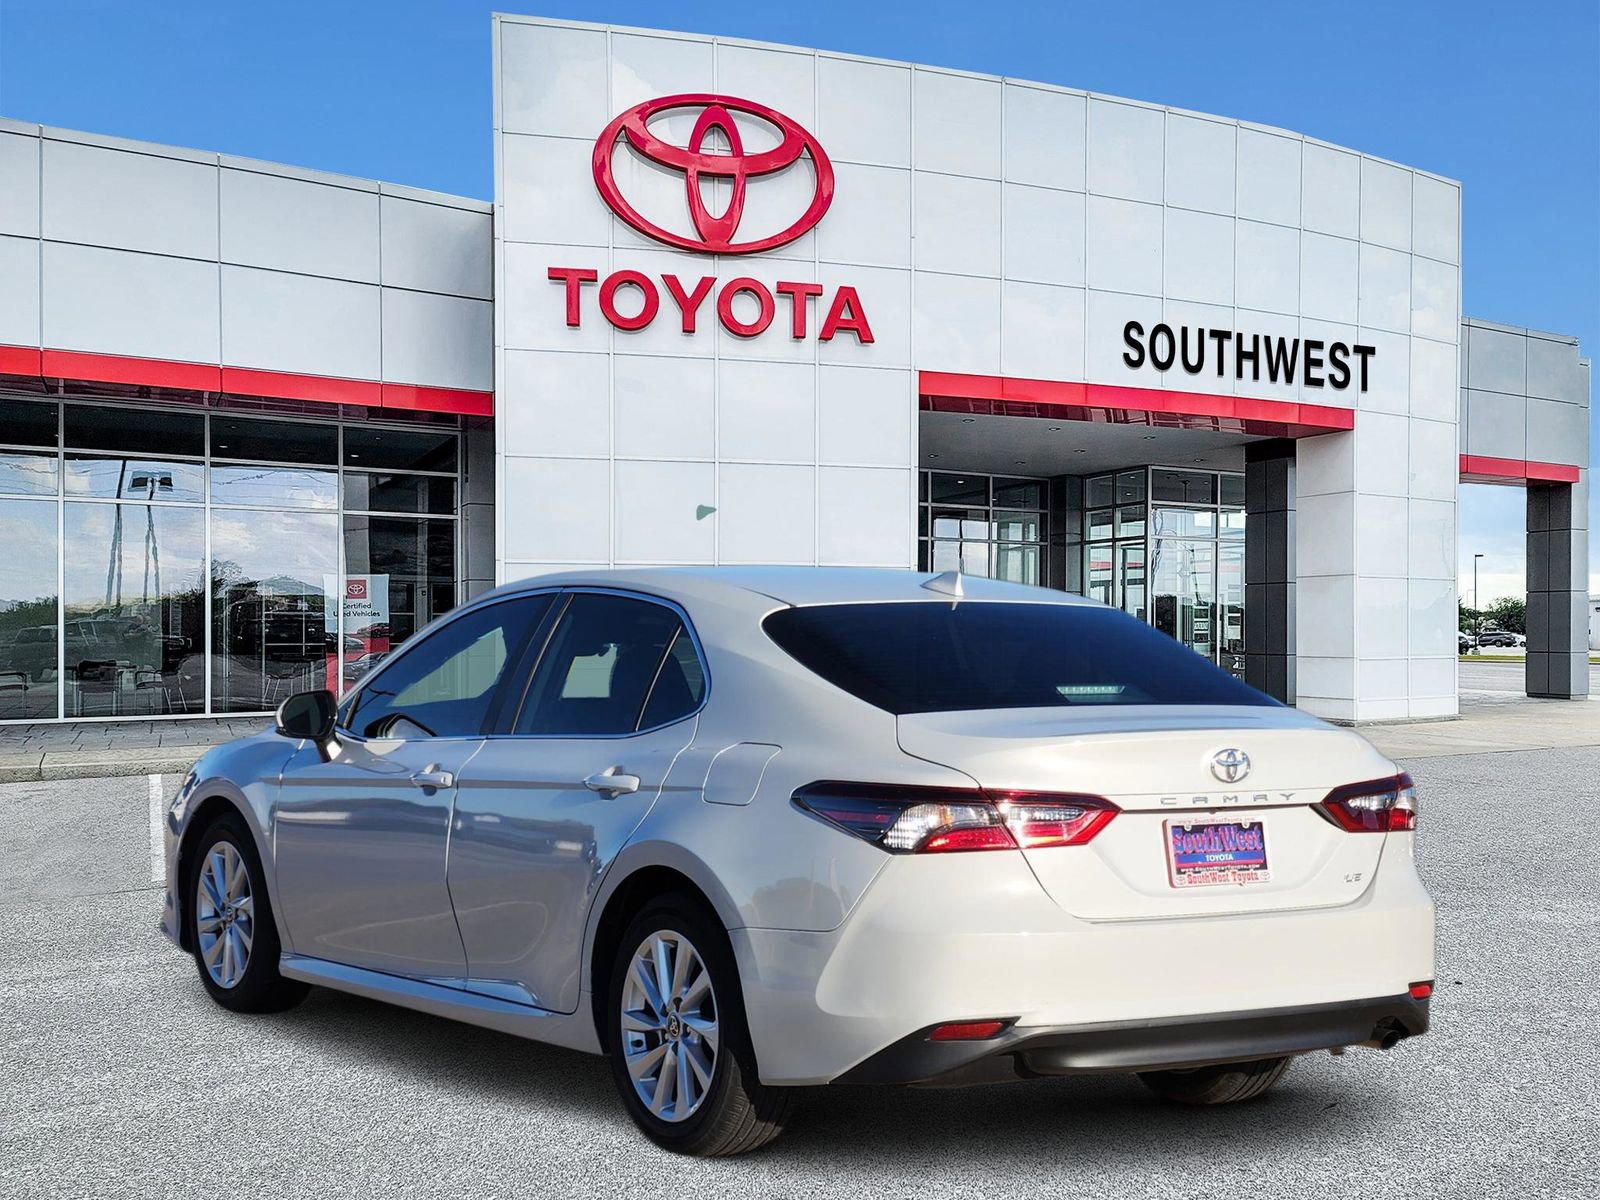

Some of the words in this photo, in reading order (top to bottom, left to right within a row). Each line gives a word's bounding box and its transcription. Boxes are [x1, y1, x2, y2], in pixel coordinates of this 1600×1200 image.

[547, 266, 876, 344] TOYOTA
[1122, 320, 1377, 393] SOUTHWEST
[1160, 792, 1296, 806] CAMRY
[1205, 853, 1234, 862] TOYOTA
[1187, 872, 1230, 885] SouthWest
[1231, 871, 1260, 884] Toyota
[1344, 872, 1362, 883] LE
